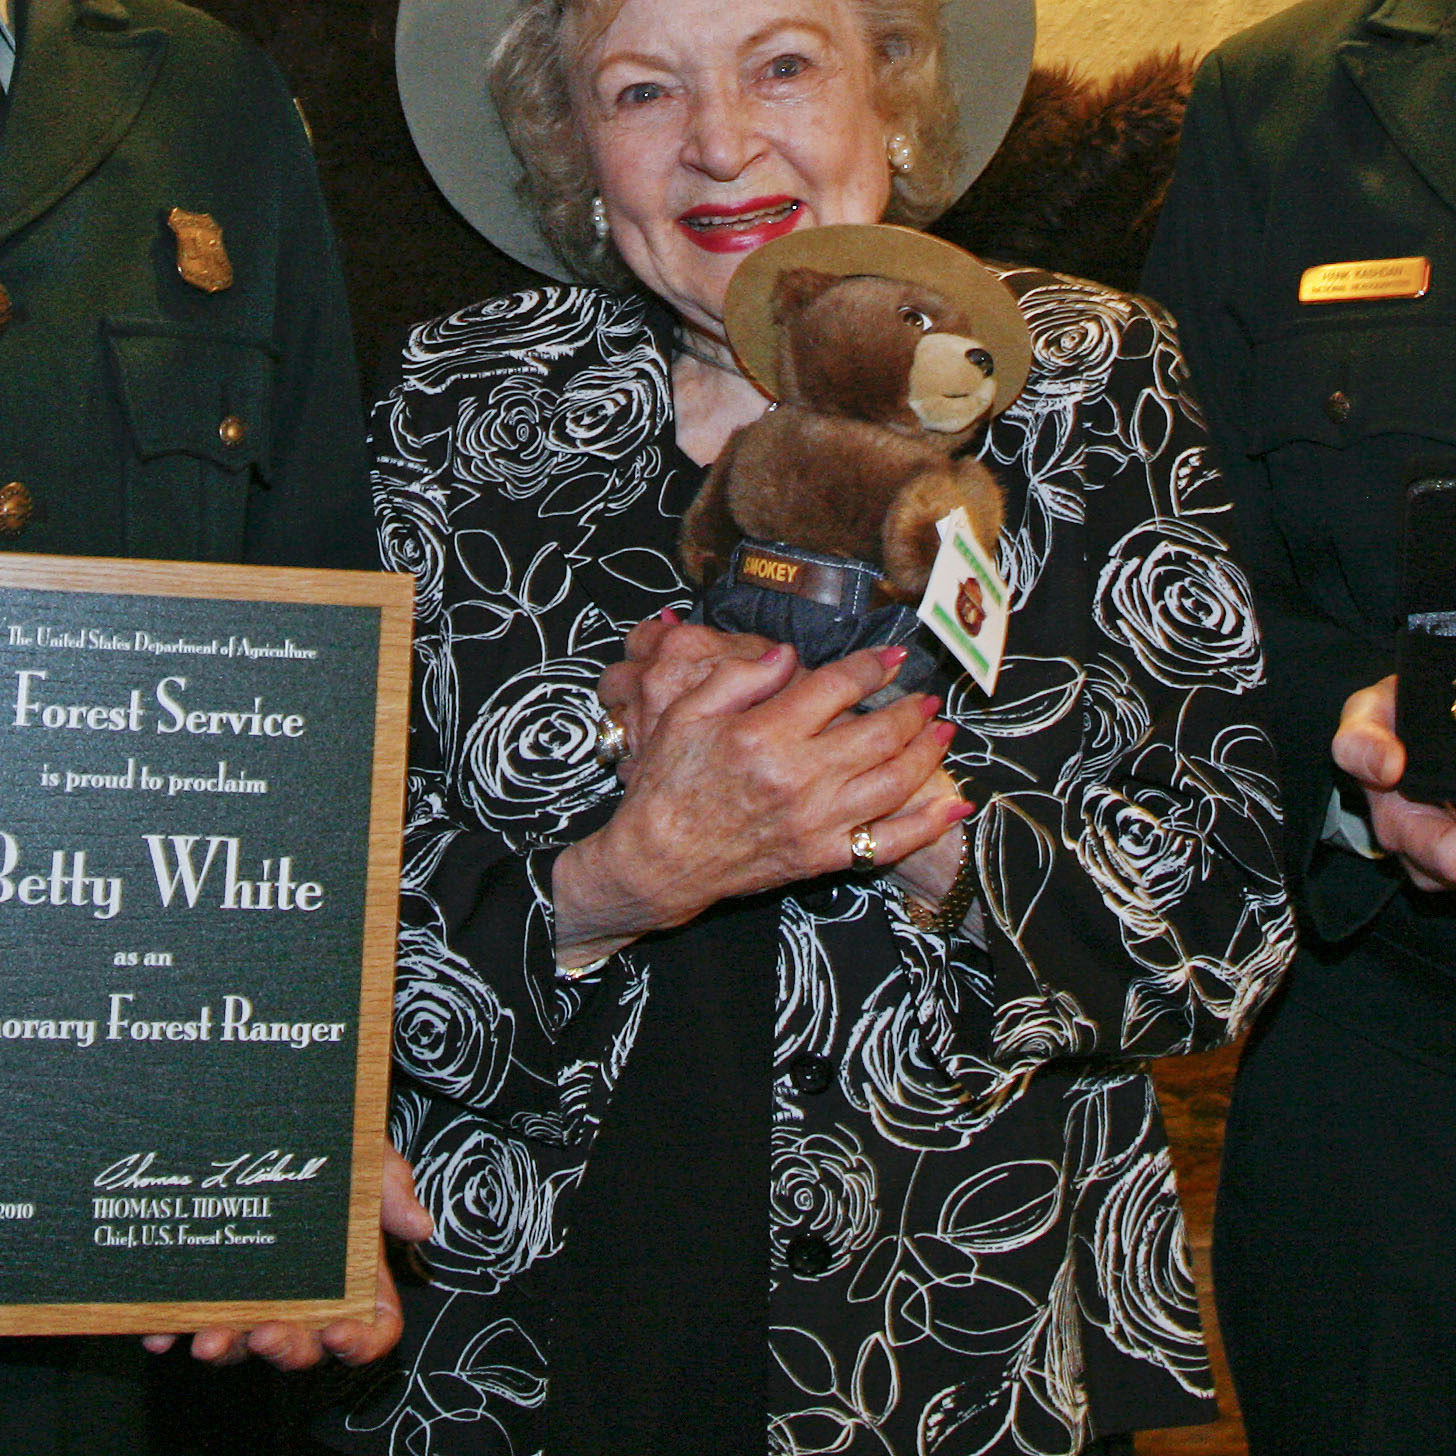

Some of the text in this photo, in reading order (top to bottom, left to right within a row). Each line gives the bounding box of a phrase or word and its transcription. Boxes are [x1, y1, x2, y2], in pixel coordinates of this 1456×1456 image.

[744, 556, 798, 583] SMOKEY
[8, 625, 317, 660] The United States Department of Agriculture
[11, 670, 305, 738] Forest Service
[41, 758, 268, 795] is proud to proclaim
[142, 834, 325, 912] White
[113, 950, 172, 967] as an
[105, 993, 212, 1041] Forest
[219, 995, 345, 1048] Ranger
[92, 1197, 171, 1219] THOMAS
[192, 1197, 271, 1219] TIDWELL
[141, 1226, 173, 1245] U.S.
[177, 1224, 221, 1245] Forest
[223, 1224, 276, 1245] Service
